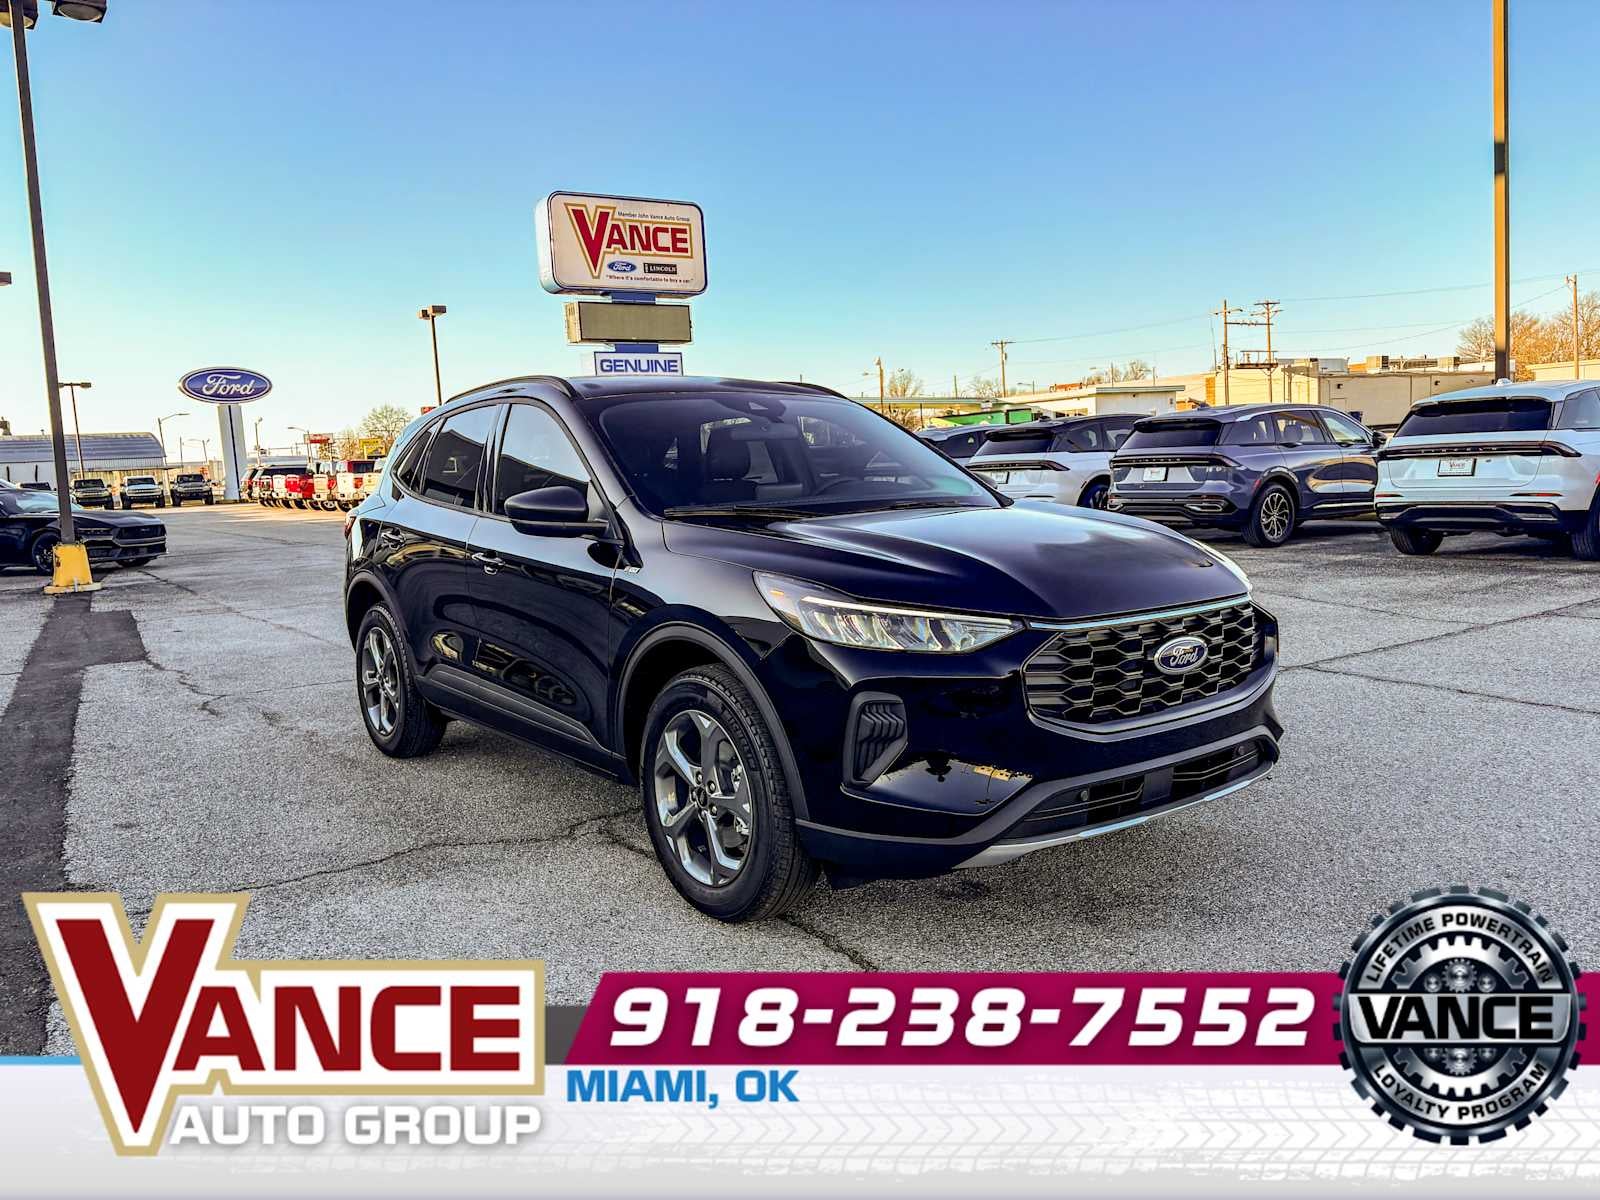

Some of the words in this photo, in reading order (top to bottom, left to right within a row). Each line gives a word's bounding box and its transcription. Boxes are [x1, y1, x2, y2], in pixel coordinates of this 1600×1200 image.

[571, 208, 689, 274] VANCE
[612, 262, 632, 271] Ford
[649, 265, 676, 273] LINCOLN
[600, 358, 679, 373] GENUINE
[202, 373, 255, 395] Ford
[1169, 645, 1199, 667] Ford
